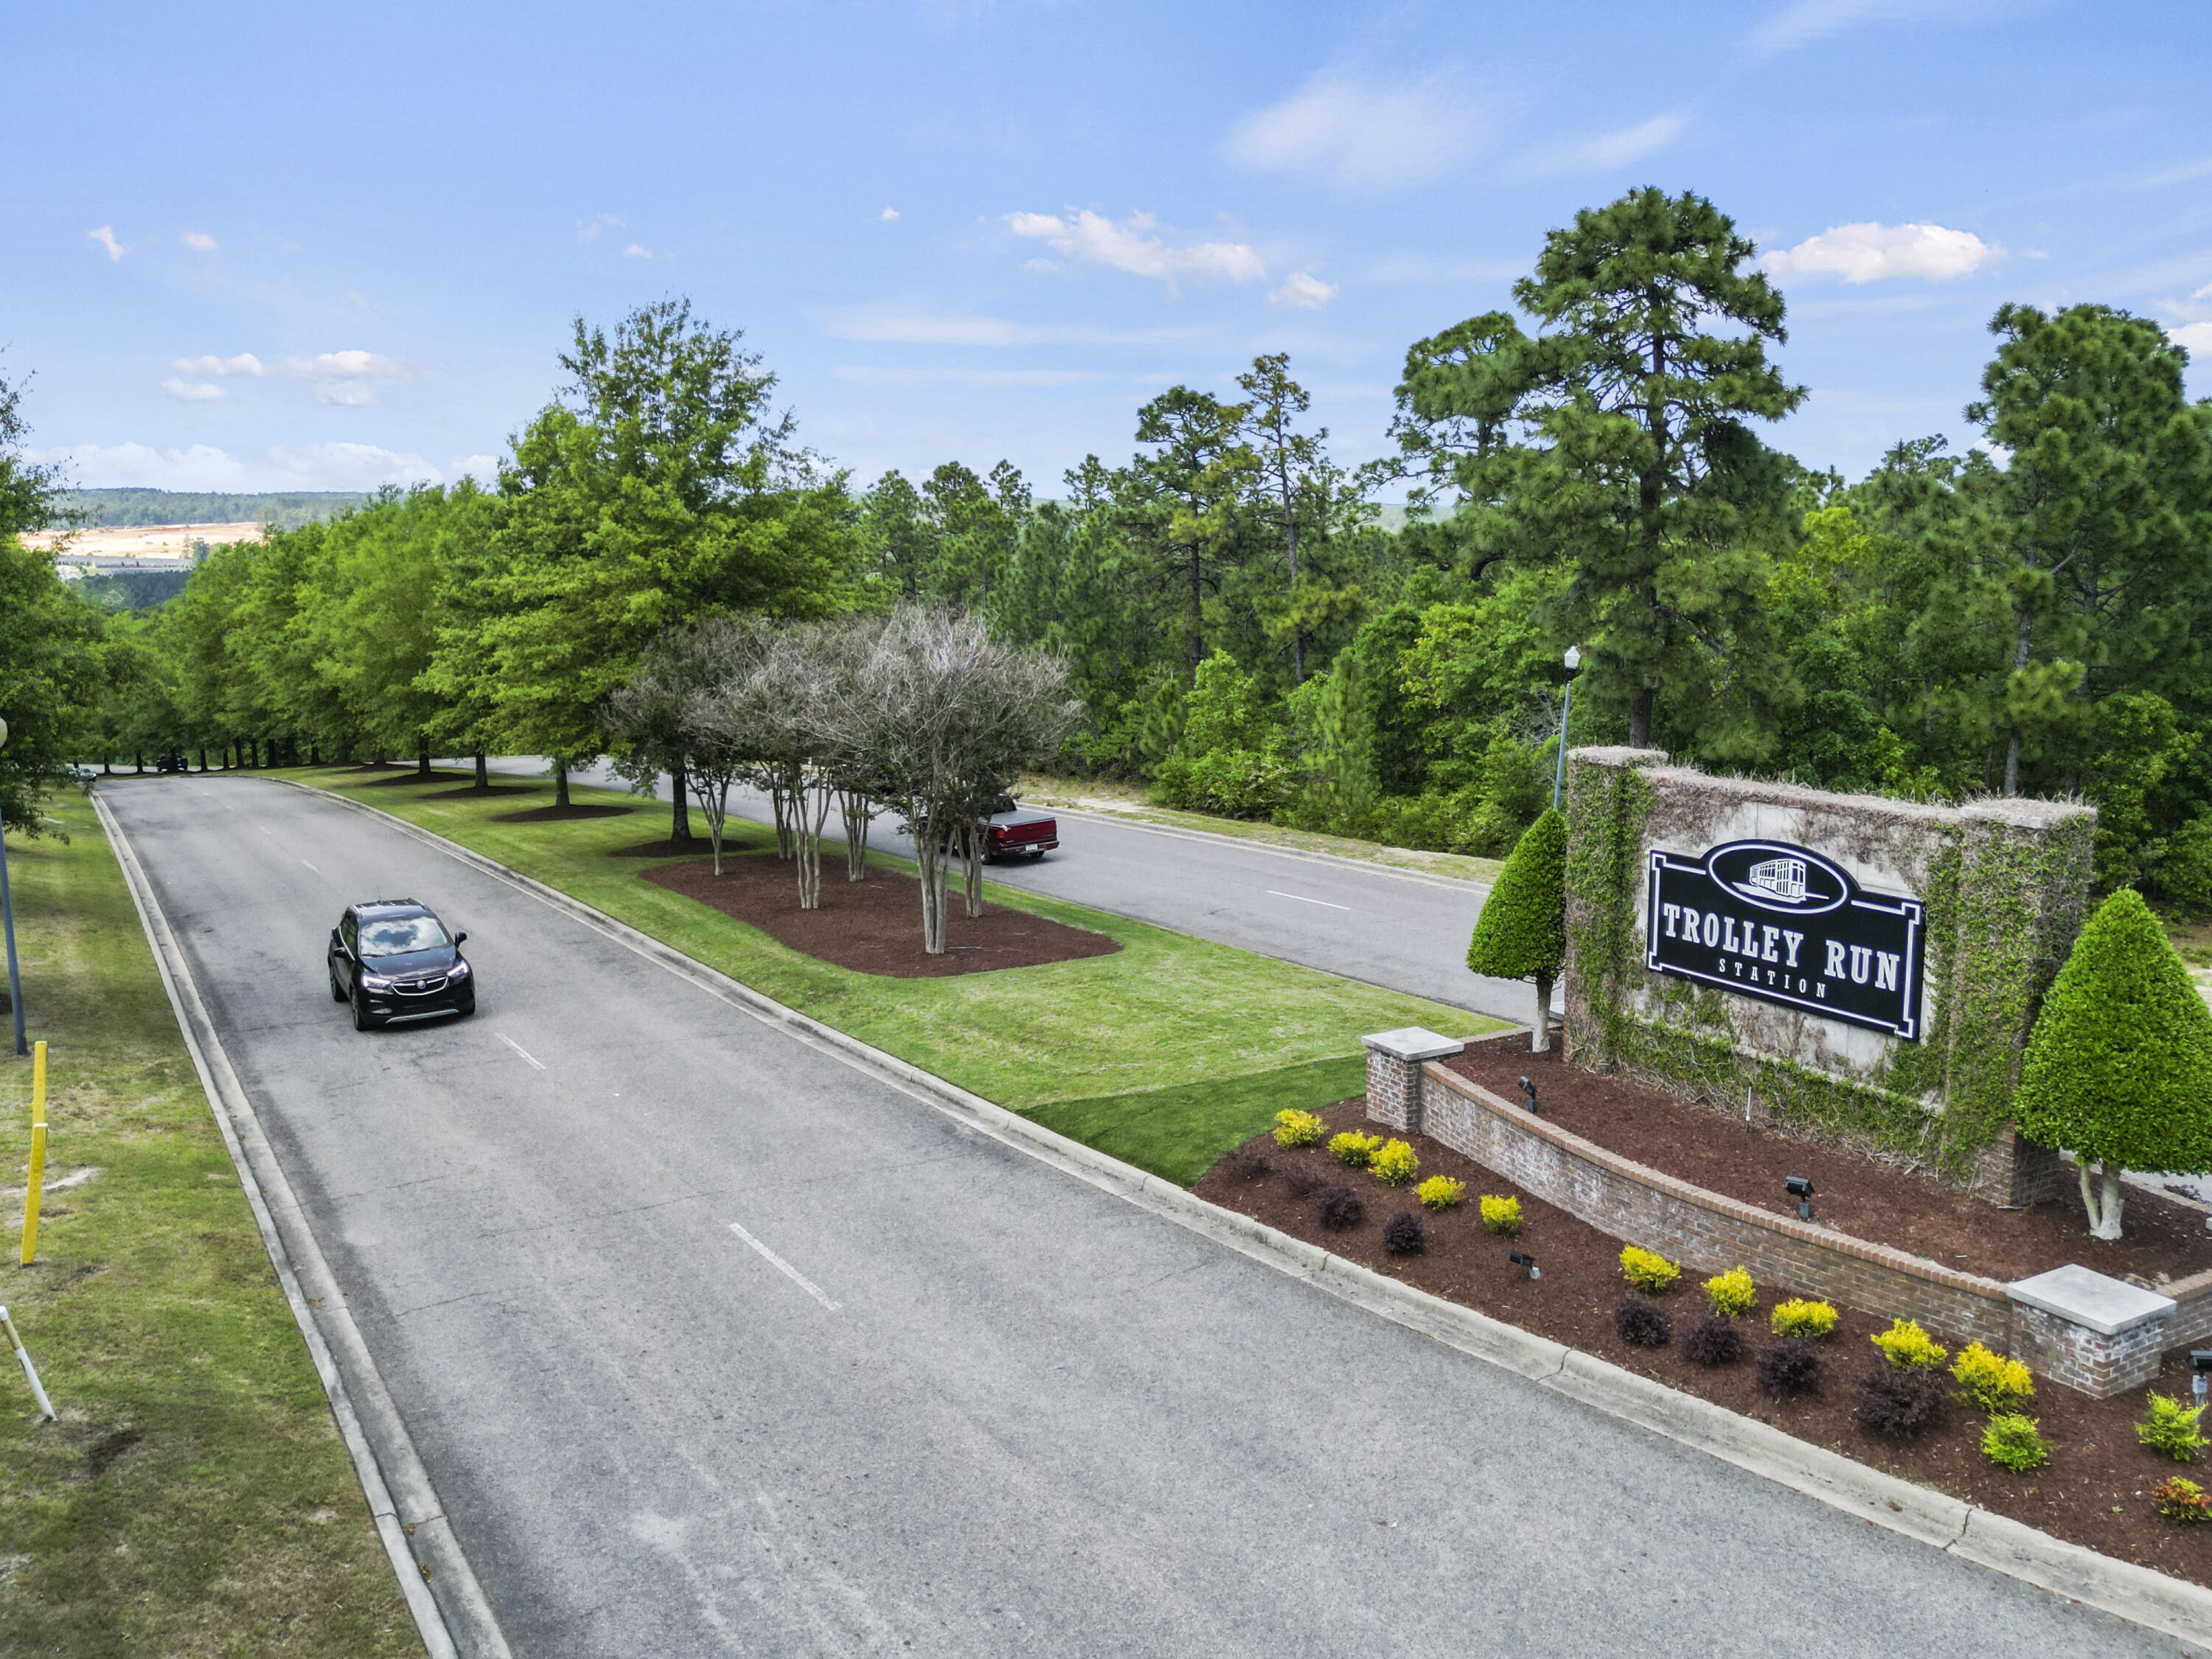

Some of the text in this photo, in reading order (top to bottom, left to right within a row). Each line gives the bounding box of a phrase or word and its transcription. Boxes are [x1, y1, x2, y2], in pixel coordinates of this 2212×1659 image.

[1663, 902, 1900, 992] TROLLEY RUN
[1719, 959, 1826, 998] STATION
